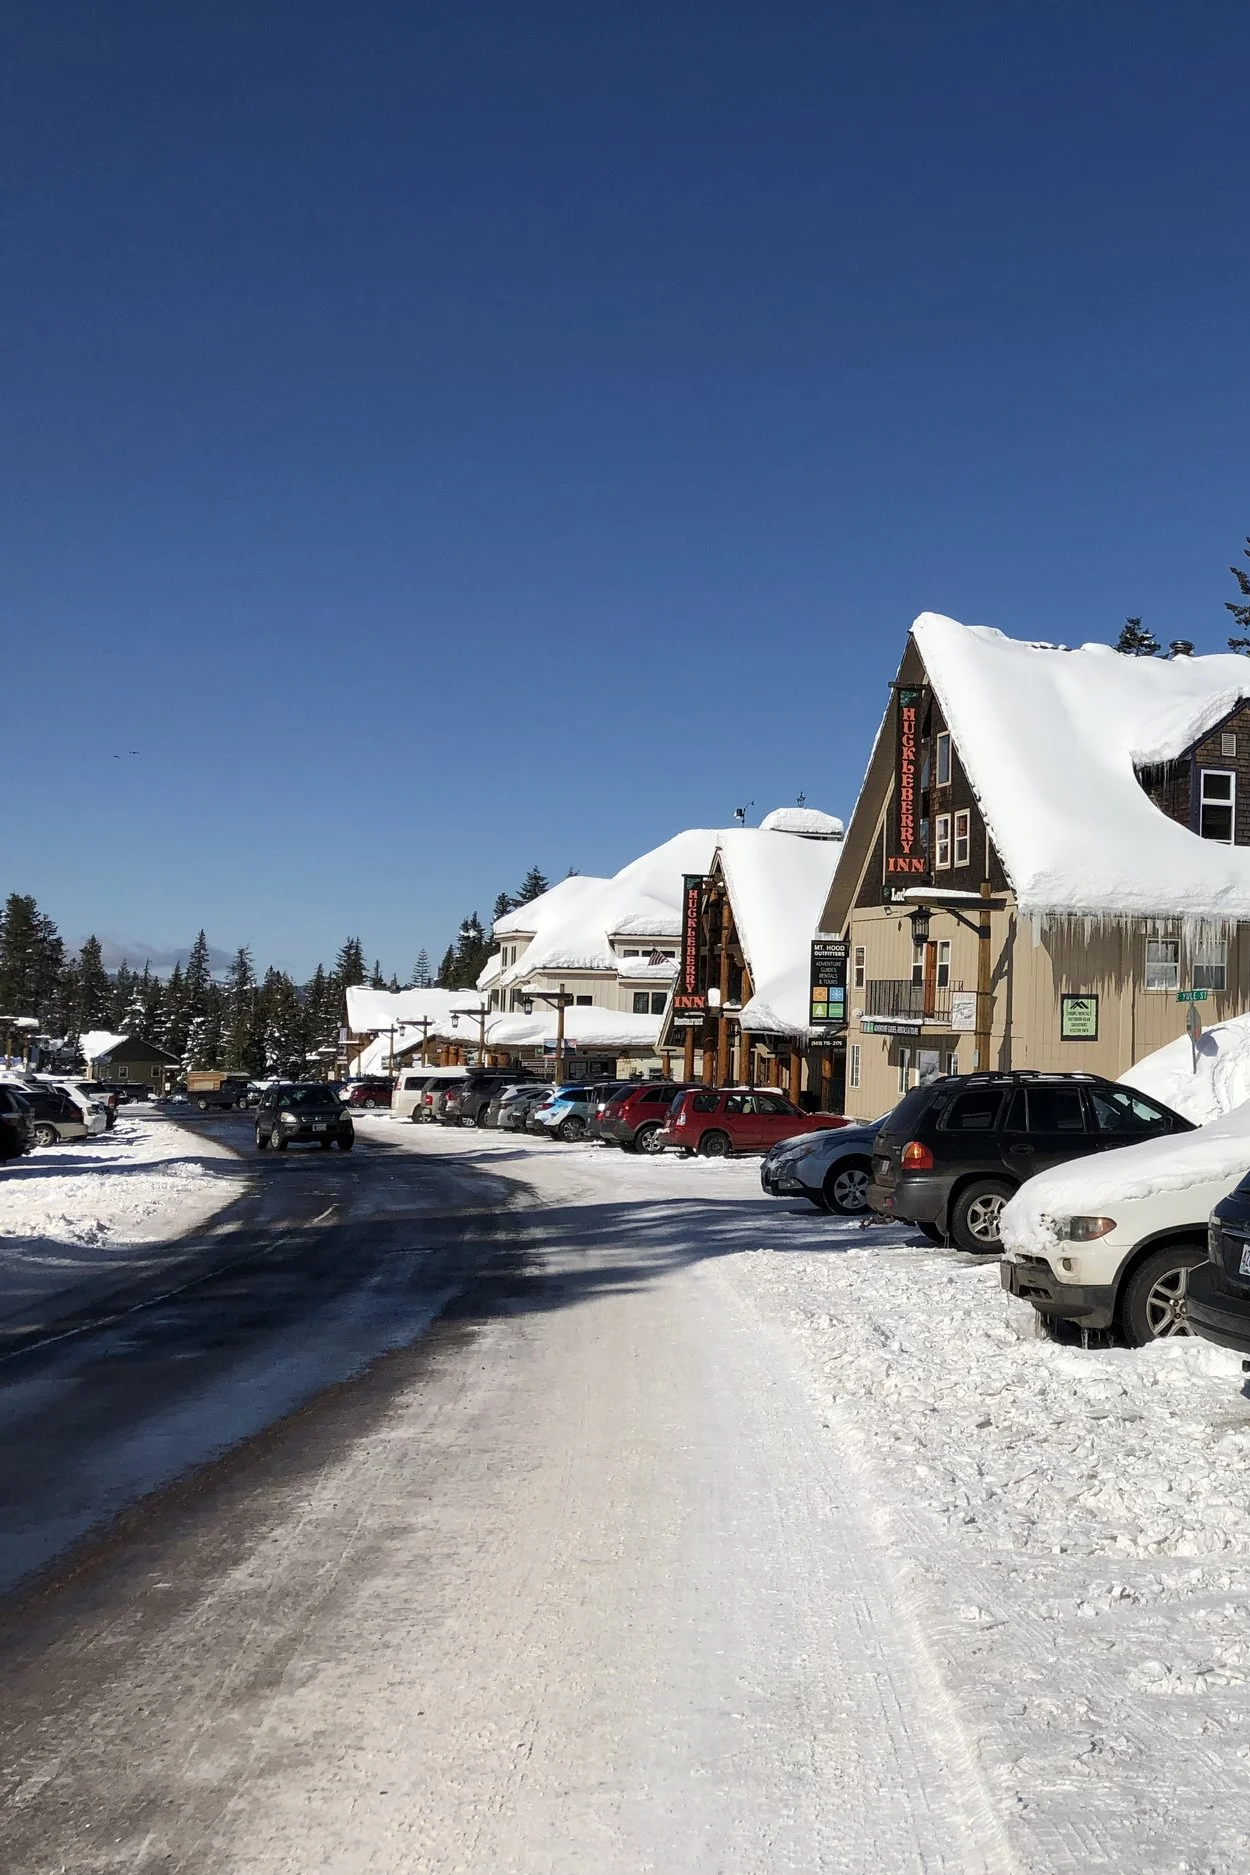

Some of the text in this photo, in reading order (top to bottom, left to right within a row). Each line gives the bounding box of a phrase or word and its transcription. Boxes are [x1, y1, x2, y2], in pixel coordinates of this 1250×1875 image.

[899, 706, 917, 855] HUCKLEBERRY
[887, 856, 925, 873] INN
[685, 889, 698, 994] HUCKLEBERRY
[674, 996, 706, 1008] INN
[1182, 992, 1197, 1000] YULE
[1200, 991, 1207, 999] ST
[673, 1016, 704, 1026] Restaurant
